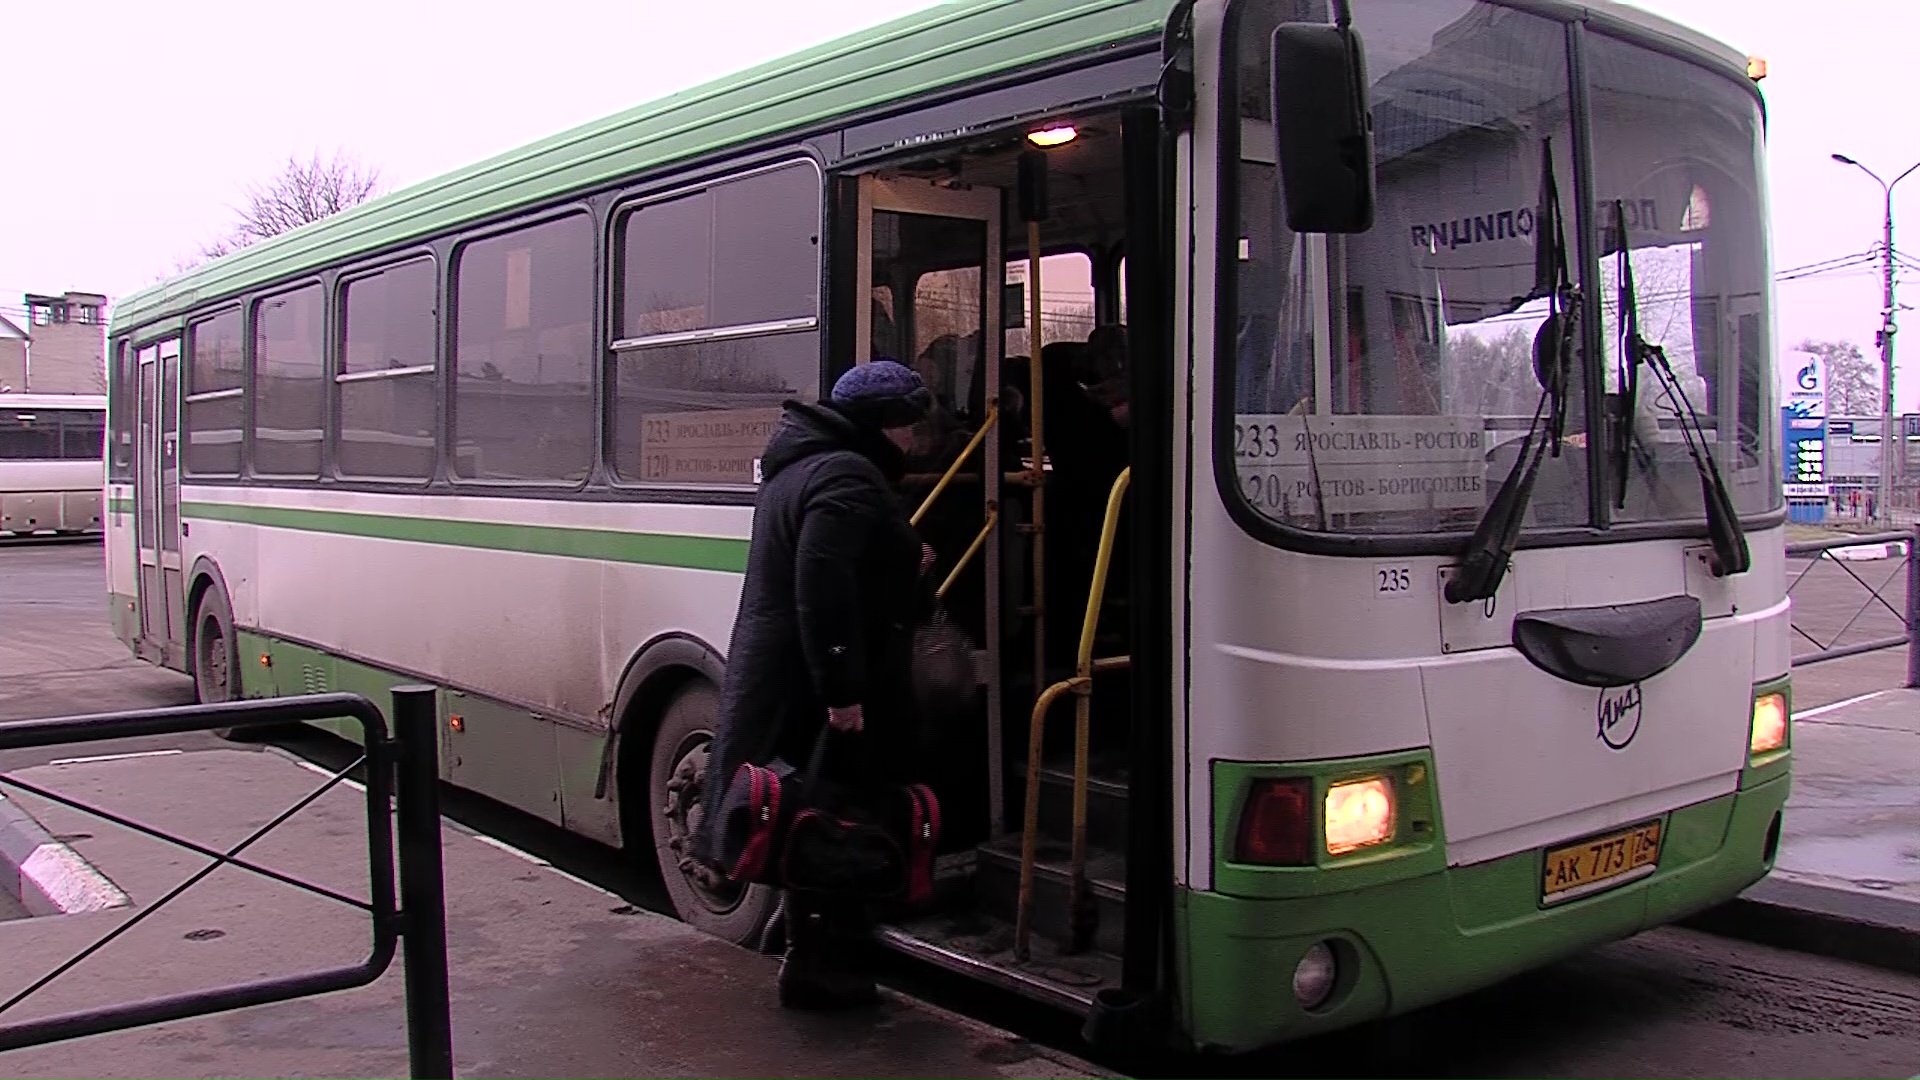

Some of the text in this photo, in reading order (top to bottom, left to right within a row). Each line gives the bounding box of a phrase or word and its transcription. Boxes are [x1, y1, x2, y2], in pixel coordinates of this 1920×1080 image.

[647, 420, 670, 443] 233
[741, 421, 777, 437] РОСТО
[1235, 424, 1280, 457] 233
[1295, 432, 1401, 451] ЯРОСЛАВЛЬ
[1415, 431, 1479, 450] РОСТОВ
[718, 458, 750, 473] БОРИС
[1240, 474, 1281, 508] 20
[1379, 476, 1481, 496] БОРИСОГЛЕБ
[1379, 569, 1410, 591] 235
[1555, 830, 1650, 885] АК 773 76
